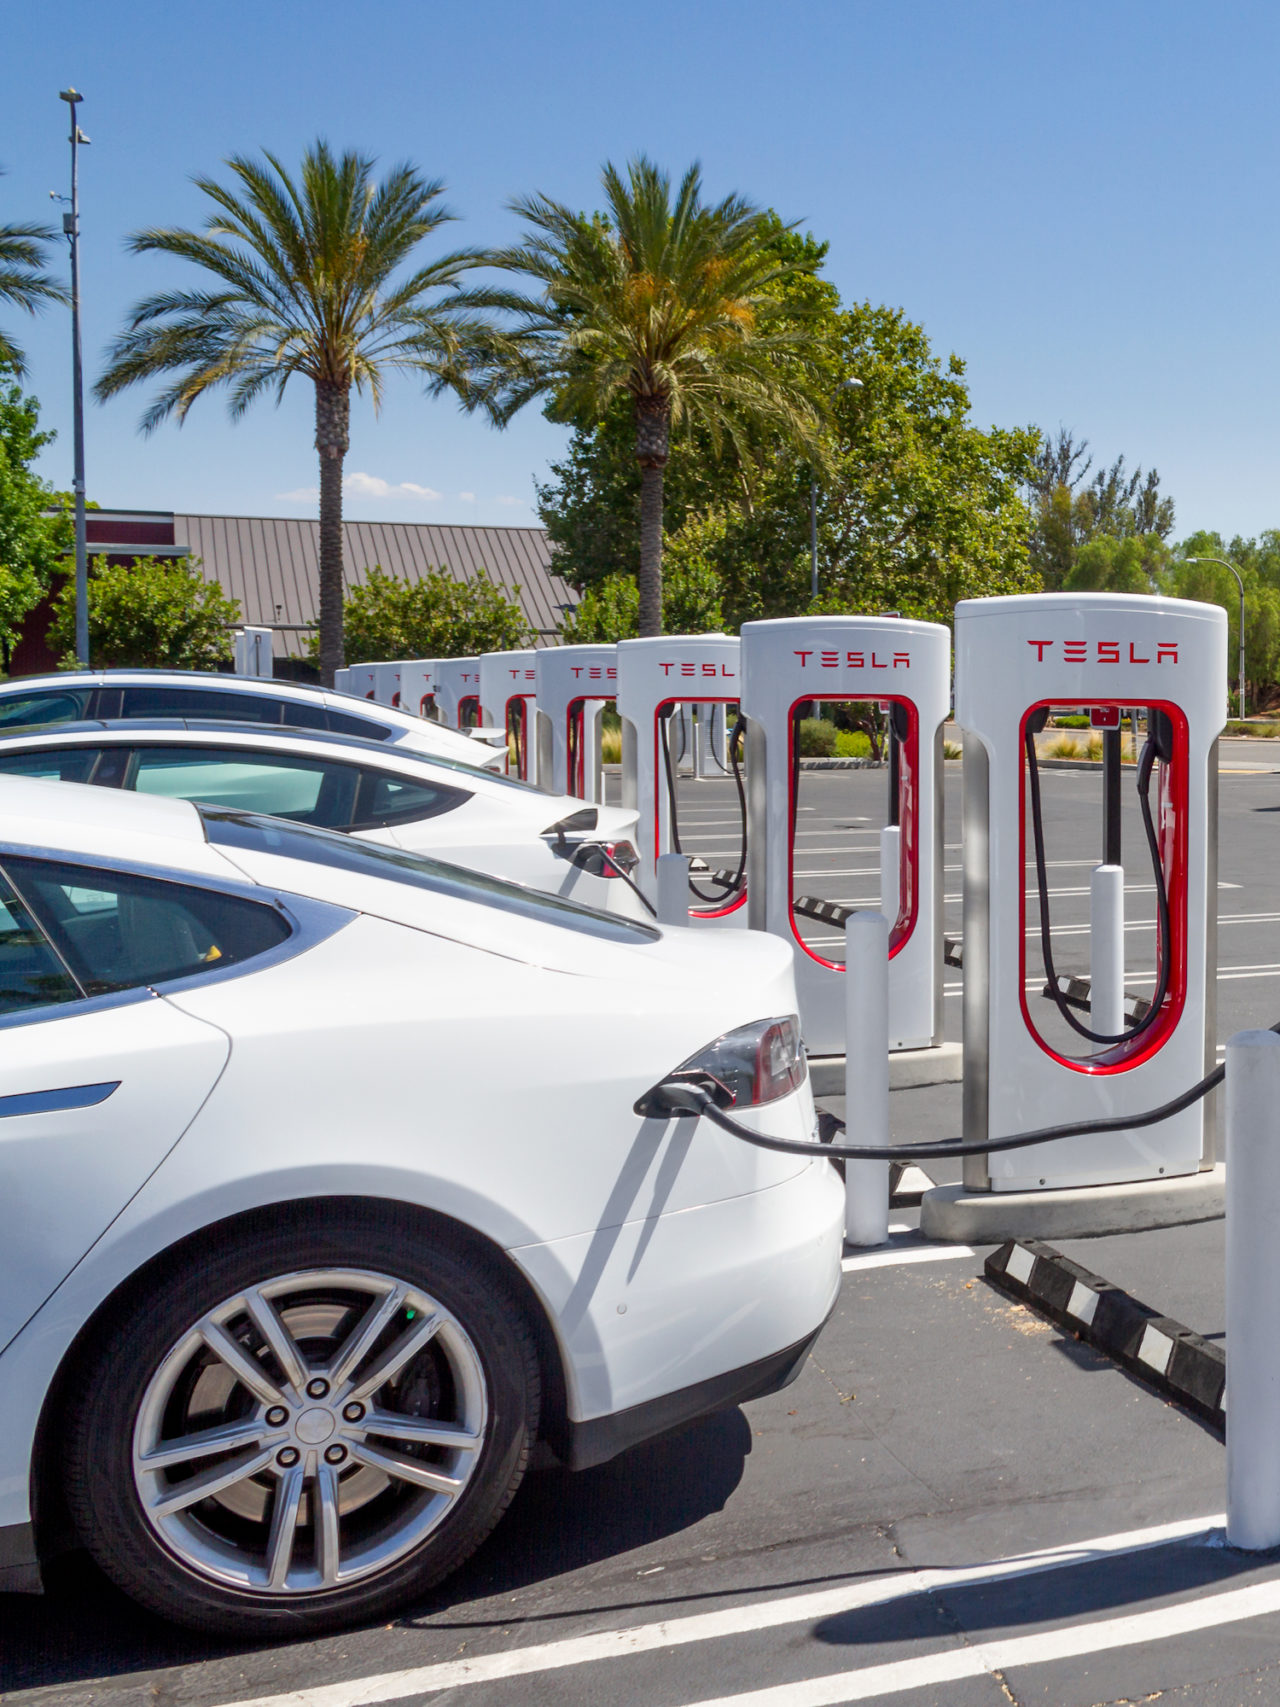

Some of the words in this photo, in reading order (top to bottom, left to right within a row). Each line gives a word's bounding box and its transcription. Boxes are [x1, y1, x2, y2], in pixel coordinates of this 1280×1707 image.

[793, 651, 911, 668] TESLA
[1027, 640, 1179, 664] TESLA
[570, 667, 617, 679] TES
[658, 663, 736, 677] TESL
